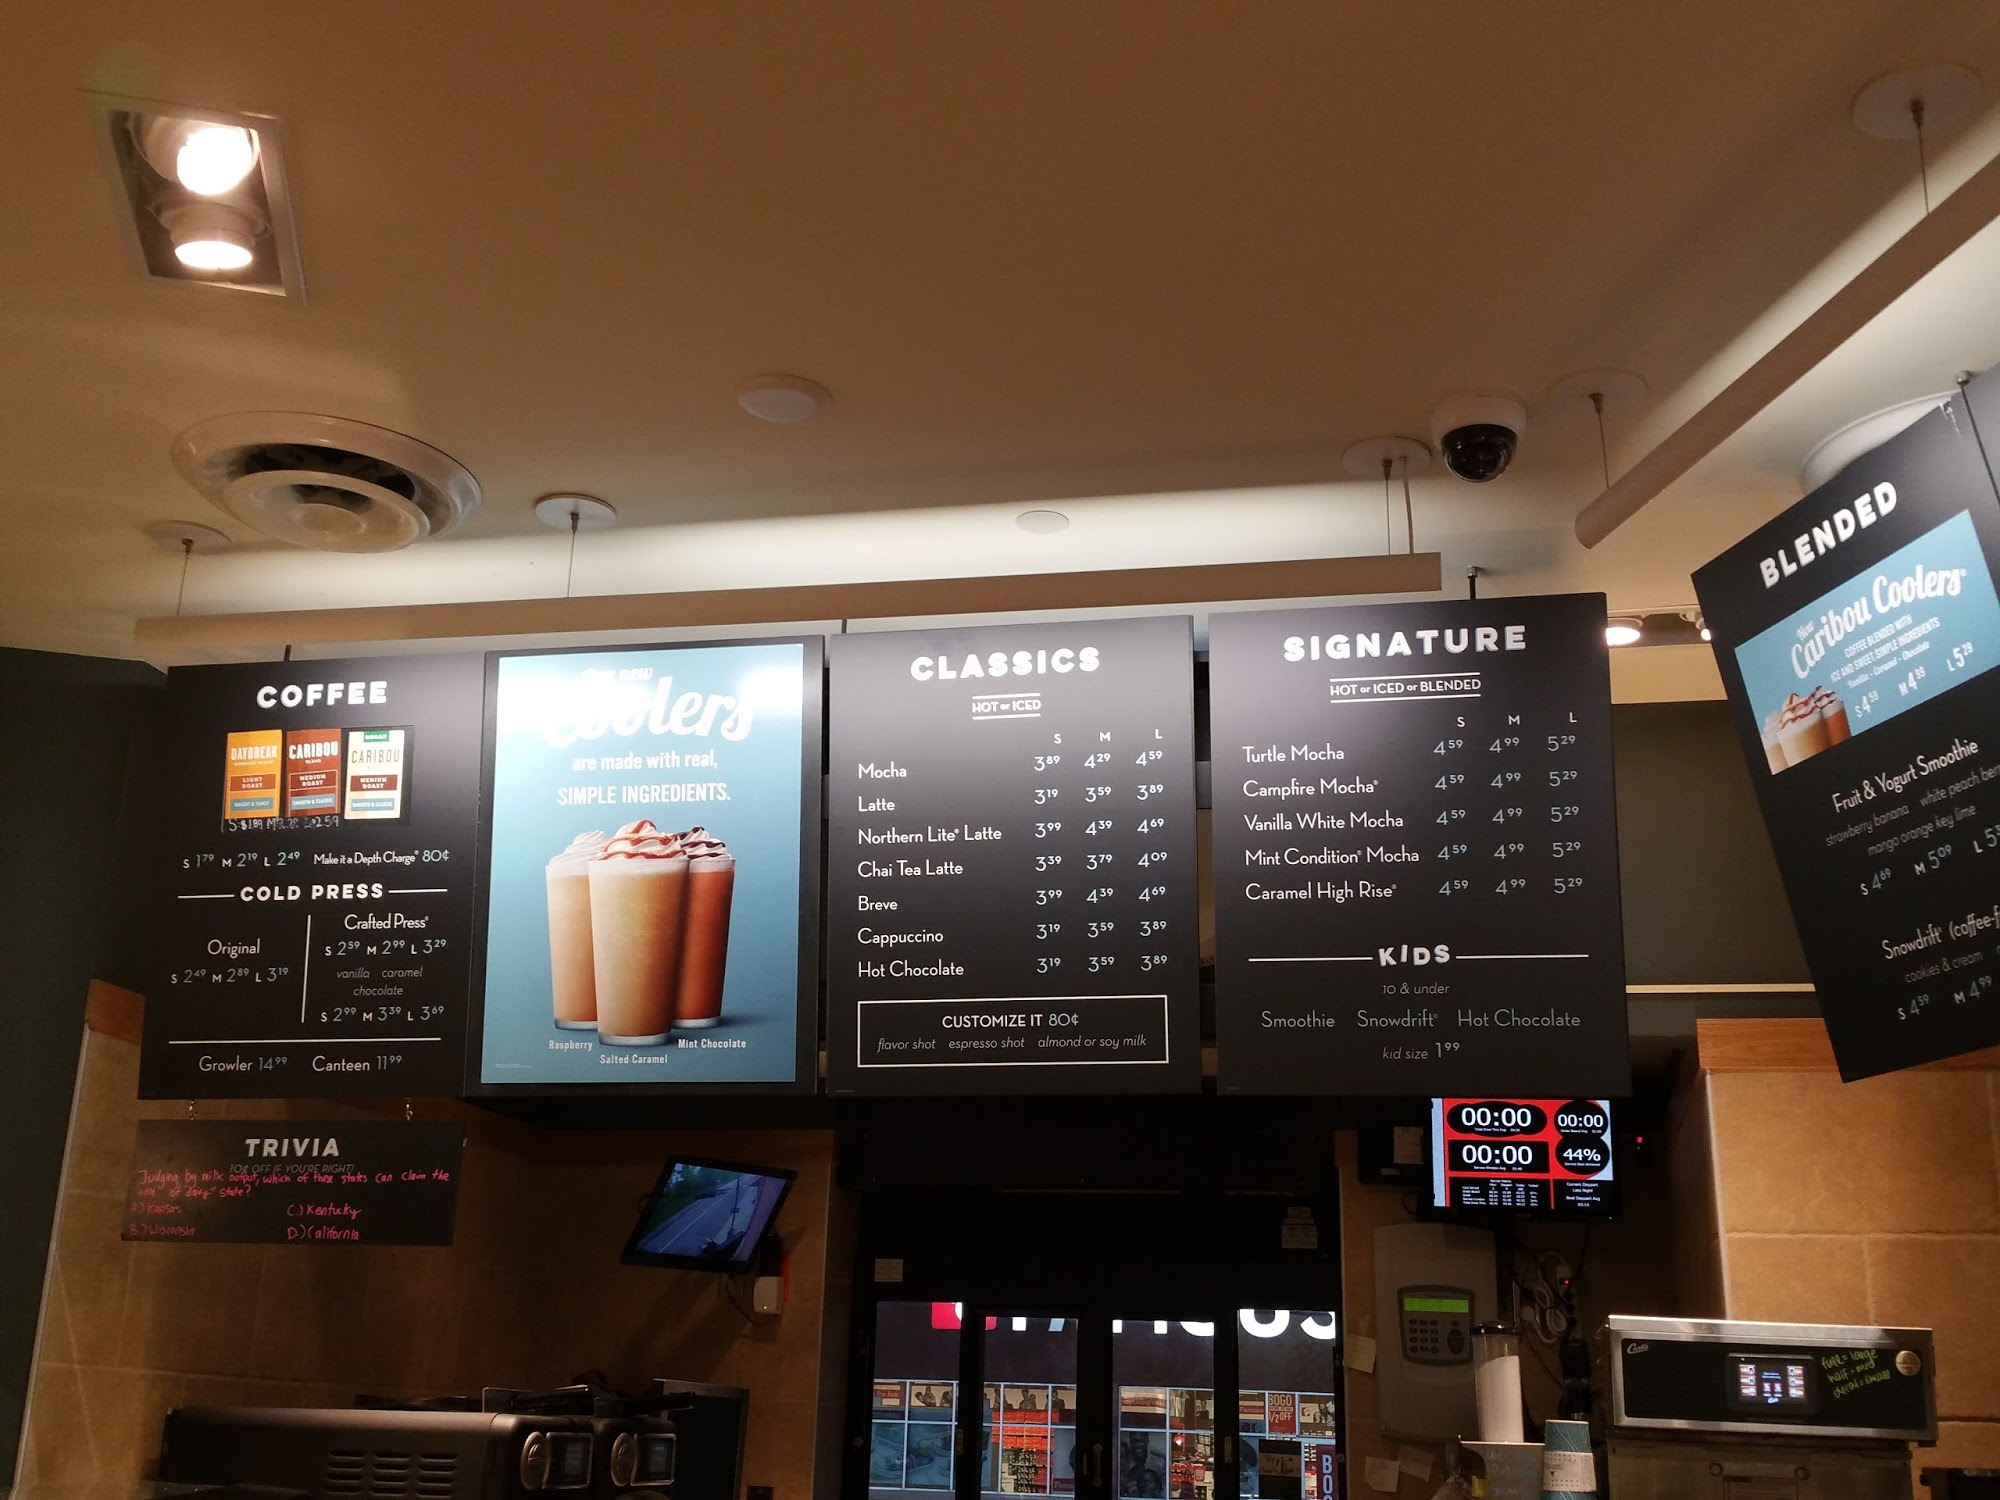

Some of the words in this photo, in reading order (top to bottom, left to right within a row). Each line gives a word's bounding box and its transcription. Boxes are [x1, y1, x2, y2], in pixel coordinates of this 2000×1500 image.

[1760, 481, 1897, 589] BLENDED
[1283, 625, 1526, 661] SIGNATURE
[1791, 596, 1872, 679] Caribou
[1845, 639, 1868, 658] COFFEE
[1894, 614, 1912, 630] WITH
[1875, 639, 1899, 658] SIMPLE
[910, 647, 1100, 681] CLASSICS
[257, 681, 387, 709] COFFEE
[1330, 684, 1357, 696] HOT
[1360, 685, 1370, 694] or
[1373, 682, 1404, 694] ICED
[1407, 683, 1417, 692] or
[1420, 678, 1481, 693] BLENDED
[972, 702, 998, 713] HOT
[1000, 703, 1010, 711] or
[1012, 699, 1041, 711] ICED
[1457, 717, 1465, 727] S
[1509, 715, 1520, 725] M
[1569, 712, 1577, 723] L
[1054, 734, 1061, 744] S
[1100, 732, 1110, 742] M
[1155, 729, 1162, 739] L
[231, 745, 278, 760] DAYBREAK
[289, 741, 338, 759] CARIBOU
[352, 750, 399, 763] CARIBOU
[1242, 745, 1286, 763] Turtle
[1291, 743, 1344, 761] Mocha
[572, 757, 596, 771] are
[601, 751, 642, 770] made
[646, 750, 680, 768] with
[685, 749, 718, 769] real,
[858, 762, 907, 779] Mocha
[1832, 790, 1863, 813] Fruit
[1863, 781, 1877, 800] &
[1875, 765, 1917, 794] Yogurt
[1917, 739, 1979, 775] Smoothie
[558, 786, 616, 806] SIMPLE
[622, 782, 731, 803] INGREDIENTS.
[1243, 777, 1315, 800] Campfire
[858, 796, 895, 812] Latte
[1826, 815, 1873, 847] strawberry
[1873, 805, 1909, 828] banana
[1920, 786, 1947, 807] white
[1949, 774, 1979, 796] peach
[1244, 813, 1292, 831] Vanilla
[1296, 811, 1345, 829] White
[1350, 809, 1403, 828] Mocha
[858, 828, 923, 845] Northern
[964, 825, 1002, 841] Latte
[1868, 837, 1899, 856] mango
[1901, 822, 1934, 844] orange
[1935, 813, 1955, 834] key
[1955, 804, 1976, 823] lime
[314, 854, 338, 865] Make
[340, 855, 346, 864] it
[347, 856, 352, 864] a
[354, 852, 381, 866] Depth
[422, 850, 449, 862] 80¢
[1245, 849, 1280, 866] Mint
[1367, 845, 1419, 863] Mocha
[857, 861, 892, 878] Chai
[896, 860, 921, 877] Tea
[926, 860, 963, 875] Latte
[240, 886, 301, 902] COLD
[311, 883, 384, 899] PRESS
[1245, 883, 1312, 900] Caramel
[1317, 881, 1353, 903] High
[858, 896, 897, 911] Breve
[344, 913, 391, 930] Crafted
[858, 927, 943, 947] Cappuccino
[207, 938, 260, 958] Original
[1378, 944, 1450, 966] KIDS
[337, 968, 370, 979] vanilla
[381, 966, 423, 978] caramel
[858, 961, 885, 977] Hot
[889, 959, 964, 977] Chocolate
[1905, 964, 1940, 983] cookies
[1942, 957, 1952, 971] &
[1953, 950, 1983, 969] cream
[353, 985, 403, 996] chocolate
[1383, 984, 1396, 995] 10
[1400, 983, 1410, 995] &
[1414, 983, 1449, 995] under
[942, 1015, 1026, 1028] CUSTOMIZE
[1030, 1014, 1043, 1027] IT
[1049, 1014, 1079, 1027] 80¢
[1261, 1011, 1335, 1028] Smoothie
[1458, 1010, 1489, 1027] Hot
[1494, 1009, 1581, 1027] Chocolate
[549, 1040, 593, 1051] Raspberry
[678, 1039, 698, 1049] Mint
[701, 1038, 746, 1048] Chocolate
[877, 1037, 909, 1052] flavor
[913, 1038, 936, 1049] shot
[949, 1038, 997, 1051] espresso
[1001, 1036, 1024, 1048] shot
[1038, 1036, 1081, 1048] almond
[1084, 1037, 1096, 1047] or
[1099, 1037, 1119, 1049] soy
[1123, 1034, 1146, 1047] milk
[600, 1055, 629, 1064] Salted
[632, 1054, 668, 1064] Caramel
[1383, 1046, 1401, 1060] kid
[1405, 1047, 1428, 1060] size
[199, 1055, 253, 1072] Growler
[313, 1056, 370, 1072] Canteen
[1461, 1107, 1531, 1127] 00:00
[1558, 1114, 1603, 1127] 00:00
[245, 1138, 340, 1157] TRIVIA
[1462, 1145, 1532, 1164] 00:00
[1563, 1149, 1601, 1161] 44%
[251, 1165, 271, 1173] OFF
[273, 1165, 282, 1173] IF
[139, 1170, 178, 1189] Judging
[185, 1170, 197, 1189] by
[202, 1171, 223, 1182] milk
[262, 1173, 291, 1184] which
[298, 1170, 308, 1183] of
[375, 1173, 392, 1182] can
[401, 1170, 425, 1181] claim
[432, 1169, 449, 1182] the
[306, 1202, 362, 1218] Kentucky
[308, 1227, 359, 1240] California
[1280, 1412, 1292, 1421] OFF
